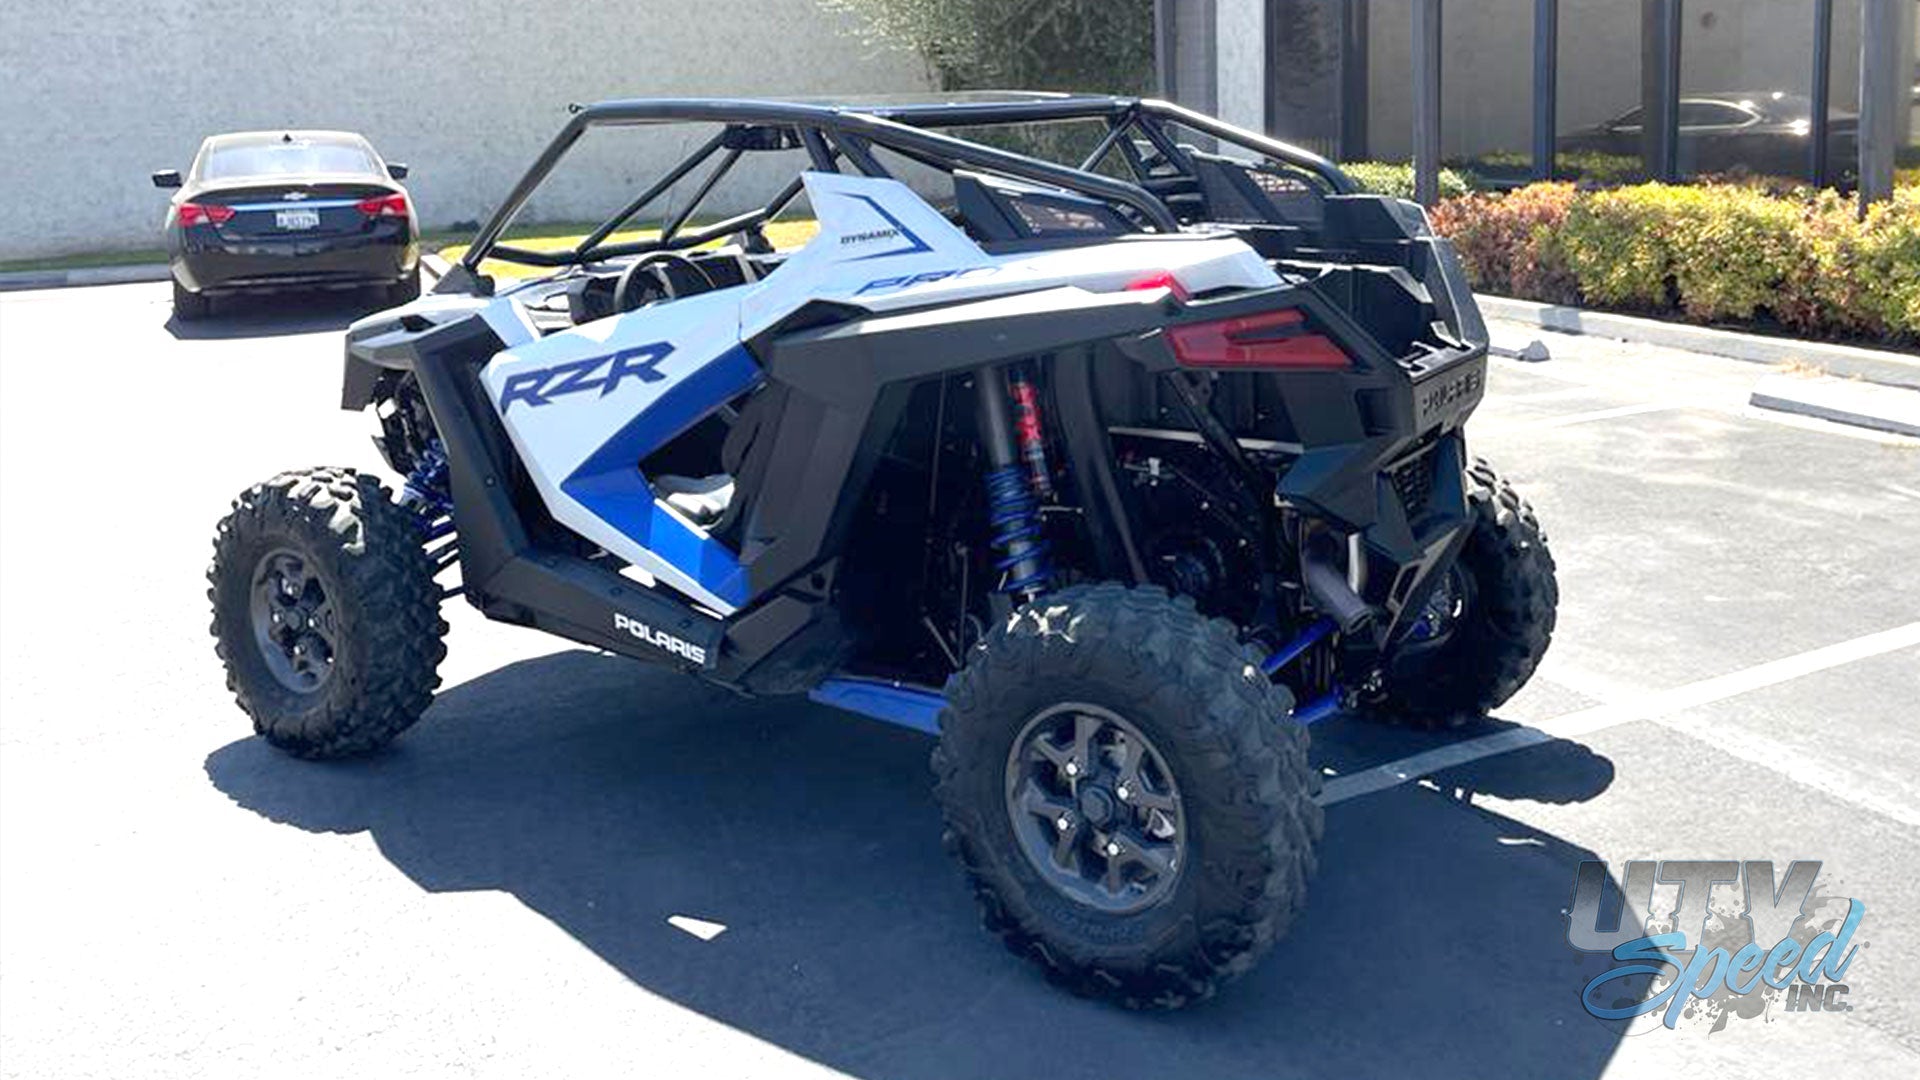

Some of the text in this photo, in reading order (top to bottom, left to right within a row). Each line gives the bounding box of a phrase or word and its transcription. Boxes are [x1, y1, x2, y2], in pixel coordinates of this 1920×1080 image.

[840, 228, 900, 245] DYNAMIX
[500, 341, 676, 416] RZR
[1421, 369, 1482, 418] POLARIS
[614, 612, 706, 664] POLARIS
